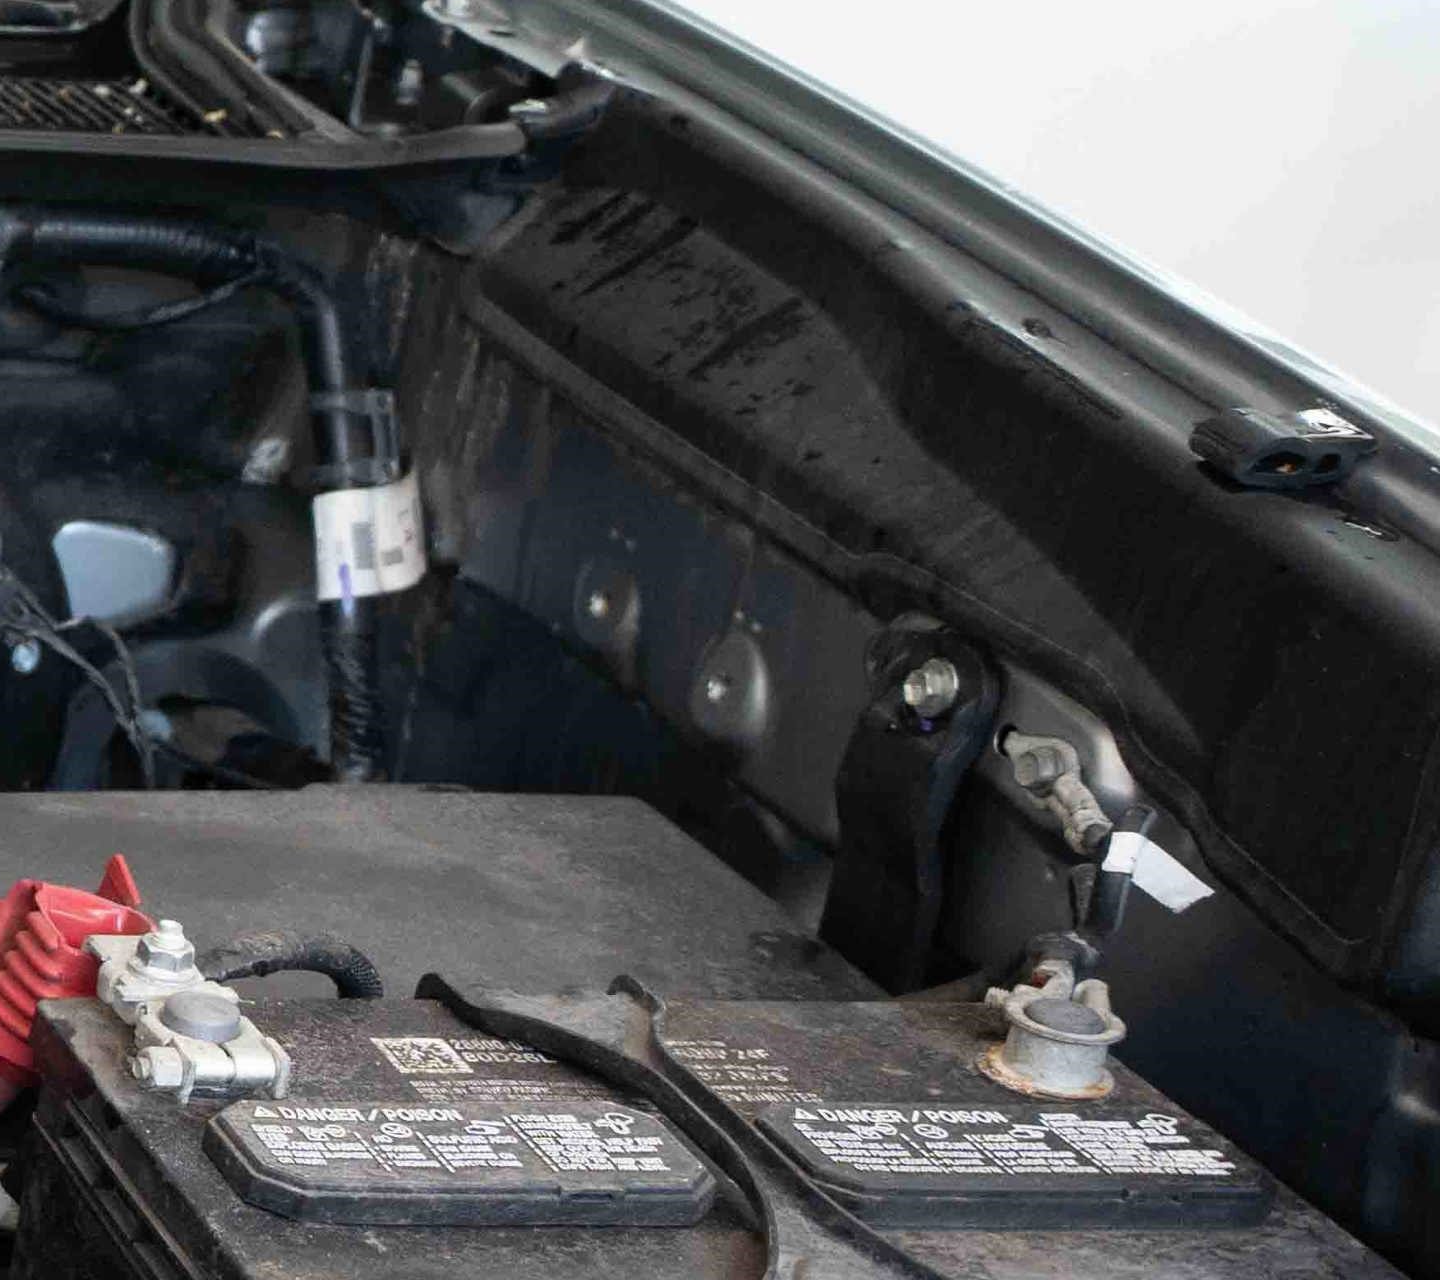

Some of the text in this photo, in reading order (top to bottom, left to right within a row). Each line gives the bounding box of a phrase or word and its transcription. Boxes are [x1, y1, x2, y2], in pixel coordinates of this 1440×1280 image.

[277, 1106, 368, 1121] DANGER
[381, 1107, 464, 1121] POISON
[816, 1108, 908, 1123] DANGER
[923, 1109, 1009, 1123] POISON
